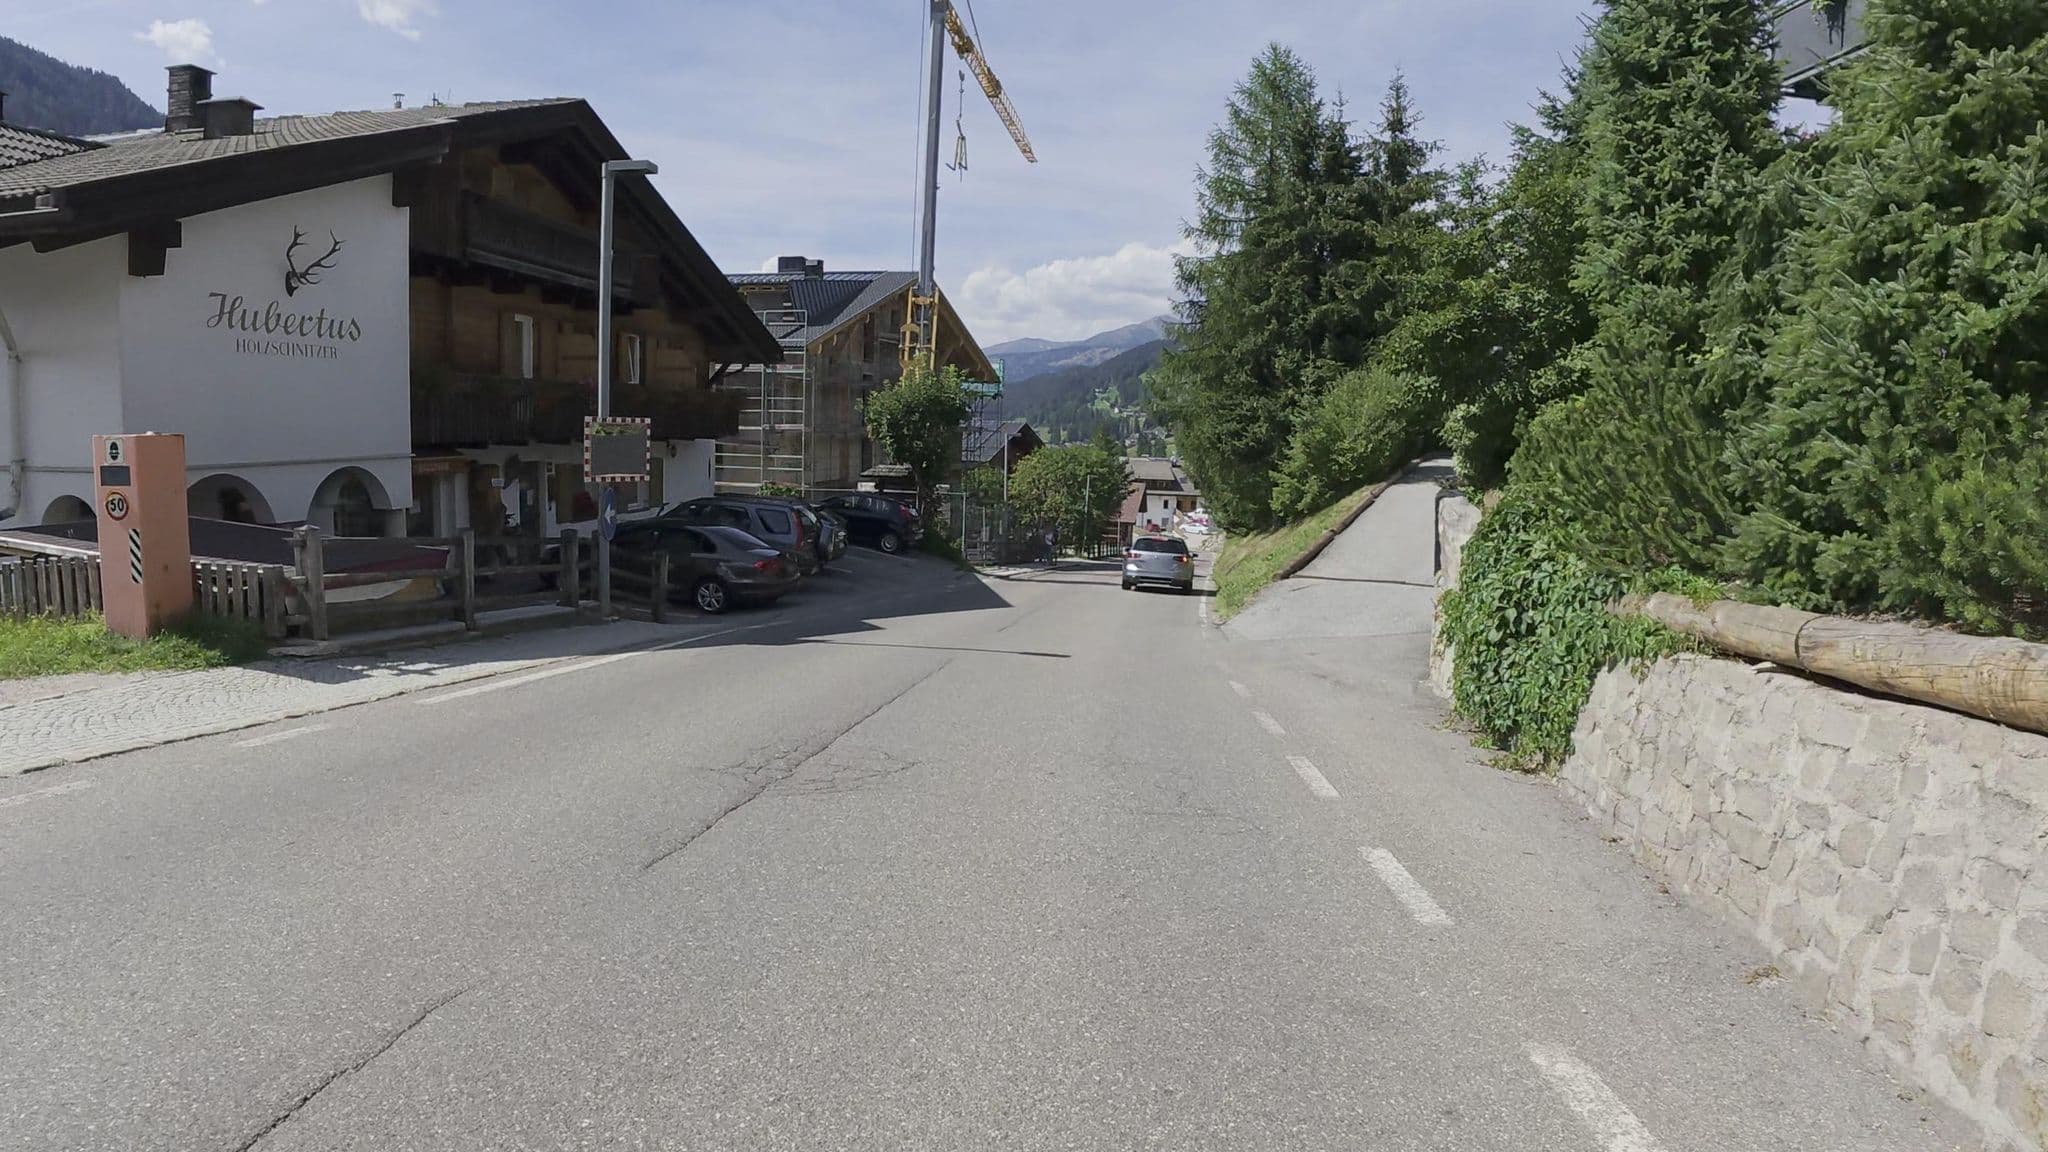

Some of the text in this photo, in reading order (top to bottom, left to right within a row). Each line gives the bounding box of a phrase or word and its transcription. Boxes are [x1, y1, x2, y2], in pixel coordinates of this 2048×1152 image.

[207, 292, 361, 341] Hubertus
[236, 338, 338, 359] HOLZSCHNITZER
[110, 498, 124, 512] 50
